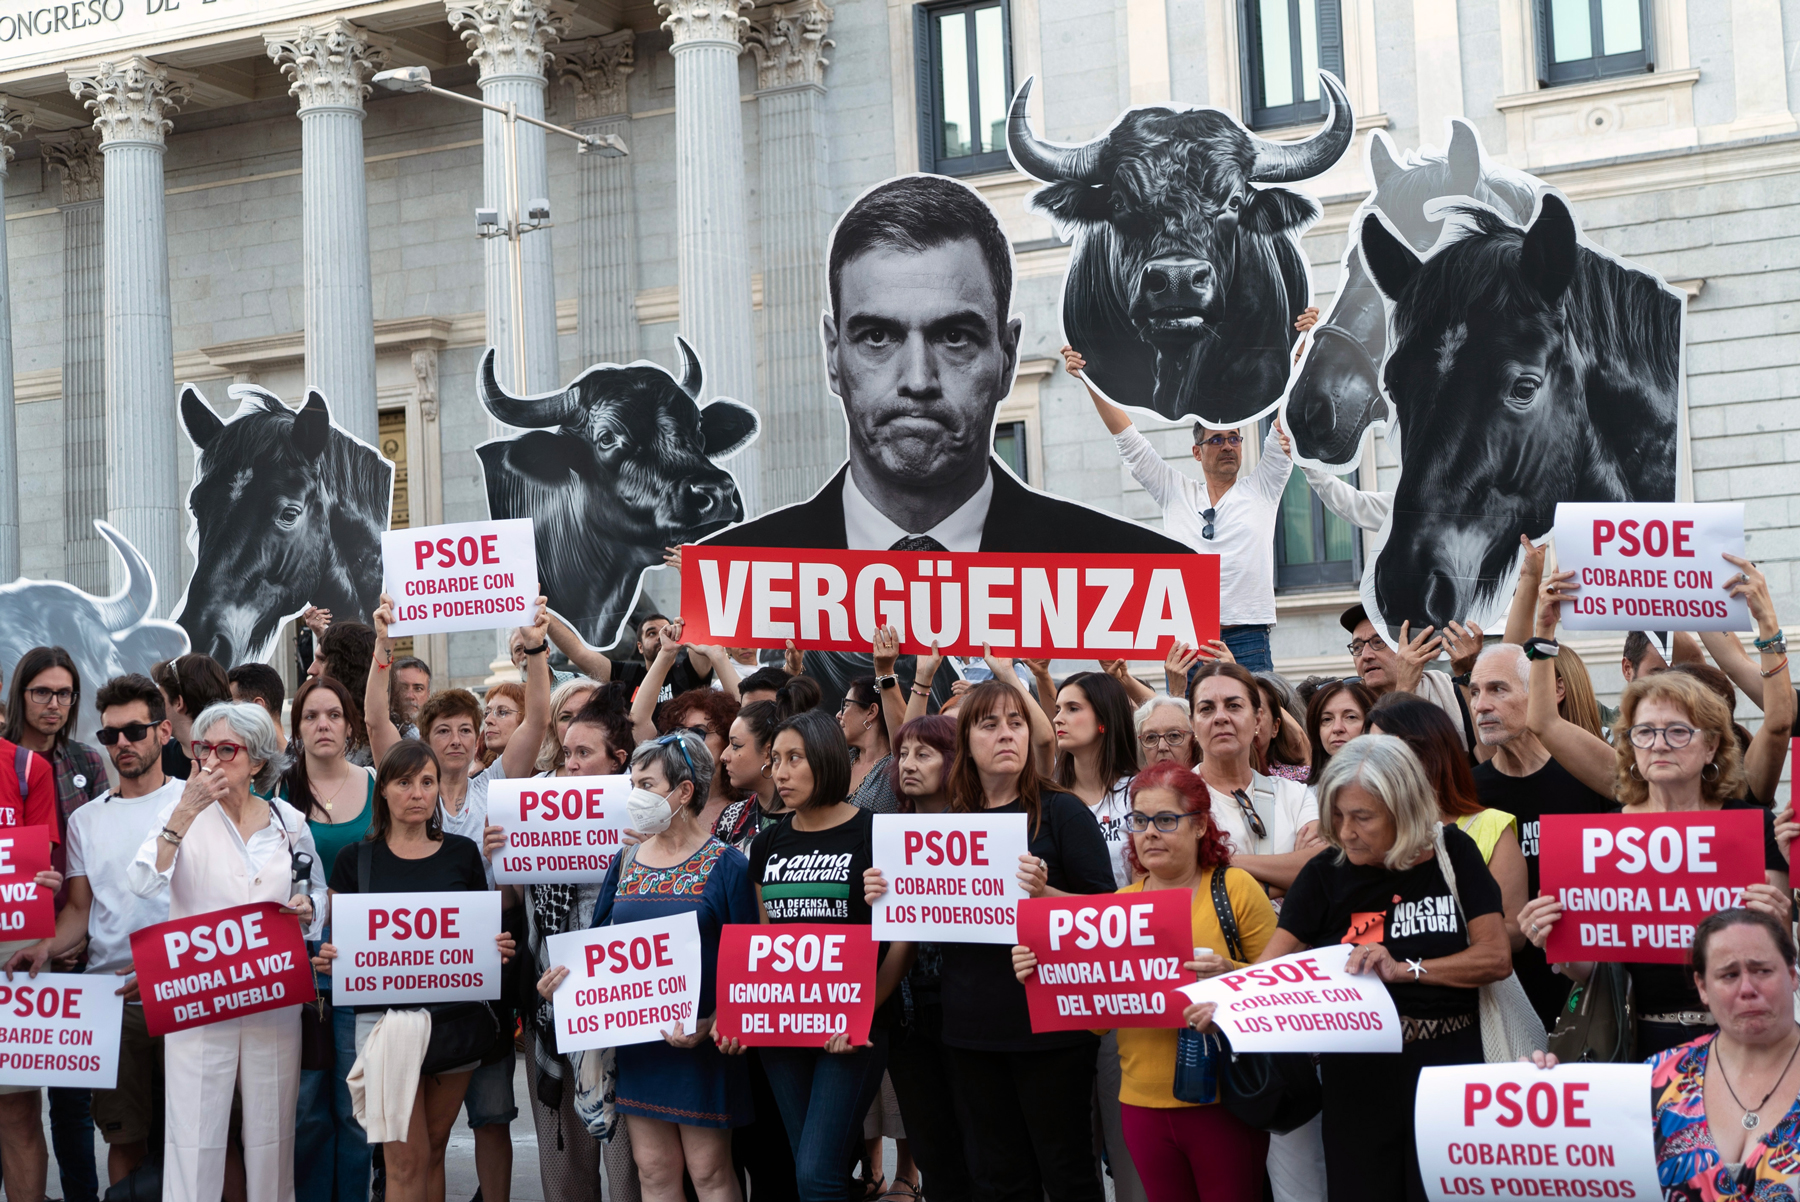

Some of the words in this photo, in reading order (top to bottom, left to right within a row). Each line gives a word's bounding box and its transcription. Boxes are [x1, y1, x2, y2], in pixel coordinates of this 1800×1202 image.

[0, 0, 124, 42] ONGRESO
[1593, 519, 1695, 558] PSOE
[414, 534, 500, 570] PSOE
[405, 575, 479, 597] COBARDE
[483, 572, 515, 590] CON
[1582, 567, 1668, 588] COBARDE
[1674, 570, 1713, 589] CON
[398, 604, 428, 621] LOS
[432, 595, 525, 618] PODEROSOS
[699, 559, 1199, 650] VERGÜENZA
[1574, 596, 1607, 615] LOS
[1612, 598, 1728, 618] PODEROSOS
[519, 788, 604, 822] PSOE
[510, 830, 582, 848] COBARDE
[586, 829, 618, 846] CON
[904, 830, 989, 867] PSOE
[1582, 825, 1718, 874] PSOE
[503, 856, 532, 872] LOS
[536, 853, 616, 872] PODEROS
[786, 849, 853, 869] anima
[781, 867, 850, 882] naturalis
[894, 877, 967, 896] COBARDE
[971, 878, 1004, 896] CON
[0, 882, 38, 903] VOZ
[774, 899, 785, 909] LA
[787, 899, 829, 908] DEFENSA
[835, 900, 848, 909] DE
[1558, 886, 1653, 912] IGNORA
[1658, 887, 1691, 912] LA
[1696, 886, 1747, 912] VOZ
[368, 907, 460, 941] PSOE
[783, 908, 799, 918] LOS
[800, 907, 848, 918] ANIMALES
[886, 905, 917, 924] LOS
[921, 906, 1015, 926] PODEROSOS
[1049, 903, 1155, 951] PSOE
[1390, 914, 1458, 939] CULTURA
[1580, 923, 1626, 947] DEL
[1631, 924, 1696, 948] PUEB
[162, 911, 270, 969] PSOE
[355, 950, 434, 967] COBARDE
[440, 949, 473, 965] CON
[584, 932, 673, 978] PSOE
[748, 933, 847, 973] PSOE
[153, 969, 227, 1002] IGNORA
[228, 961, 255, 989] LA
[256, 950, 295, 976] VOZ
[345, 976, 377, 992] LOS
[383, 973, 483, 990] PODEROSOS
[1037, 961, 1107, 985] IGNORA
[1109, 959, 1136, 983] LA
[1138, 957, 1181, 981] VOZ
[1218, 956, 1332, 992] PSOE
[173, 1000, 210, 1022] DEL
[213, 982, 285, 1013] PUEBLO
[575, 980, 654, 1007] COBARDE
[657, 975, 687, 995] CON
[729, 982, 795, 1004] IGNORA
[799, 983, 823, 1003] LA
[826, 982, 862, 1004] VOZ
[1056, 994, 1092, 1016] DEL
[1092, 991, 1166, 1015] PUEBLO
[1229, 988, 1322, 1013] COBARDE
[1320, 986, 1363, 1003] CON
[567, 1015, 599, 1035] LOS
[604, 1001, 692, 1030] PODEROSOS
[741, 1013, 775, 1033] DEL
[778, 1013, 847, 1035] PUEBLO
[1232, 1016, 1273, 1034] LOS
[1273, 1010, 1383, 1032] PODEROSOS
[0, 1026, 55, 1045] BARDE
[58, 1028, 94, 1047] CON
[0, 1052, 101, 1072] PODEROSOS
[1464, 1081, 1591, 1128] PSOE
[1447, 1142, 1560, 1167] COBARDE
[1564, 1143, 1616, 1168] CON
[1439, 1176, 1486, 1197] LOS
[1489, 1177, 1637, 1199] PODEROSOS
